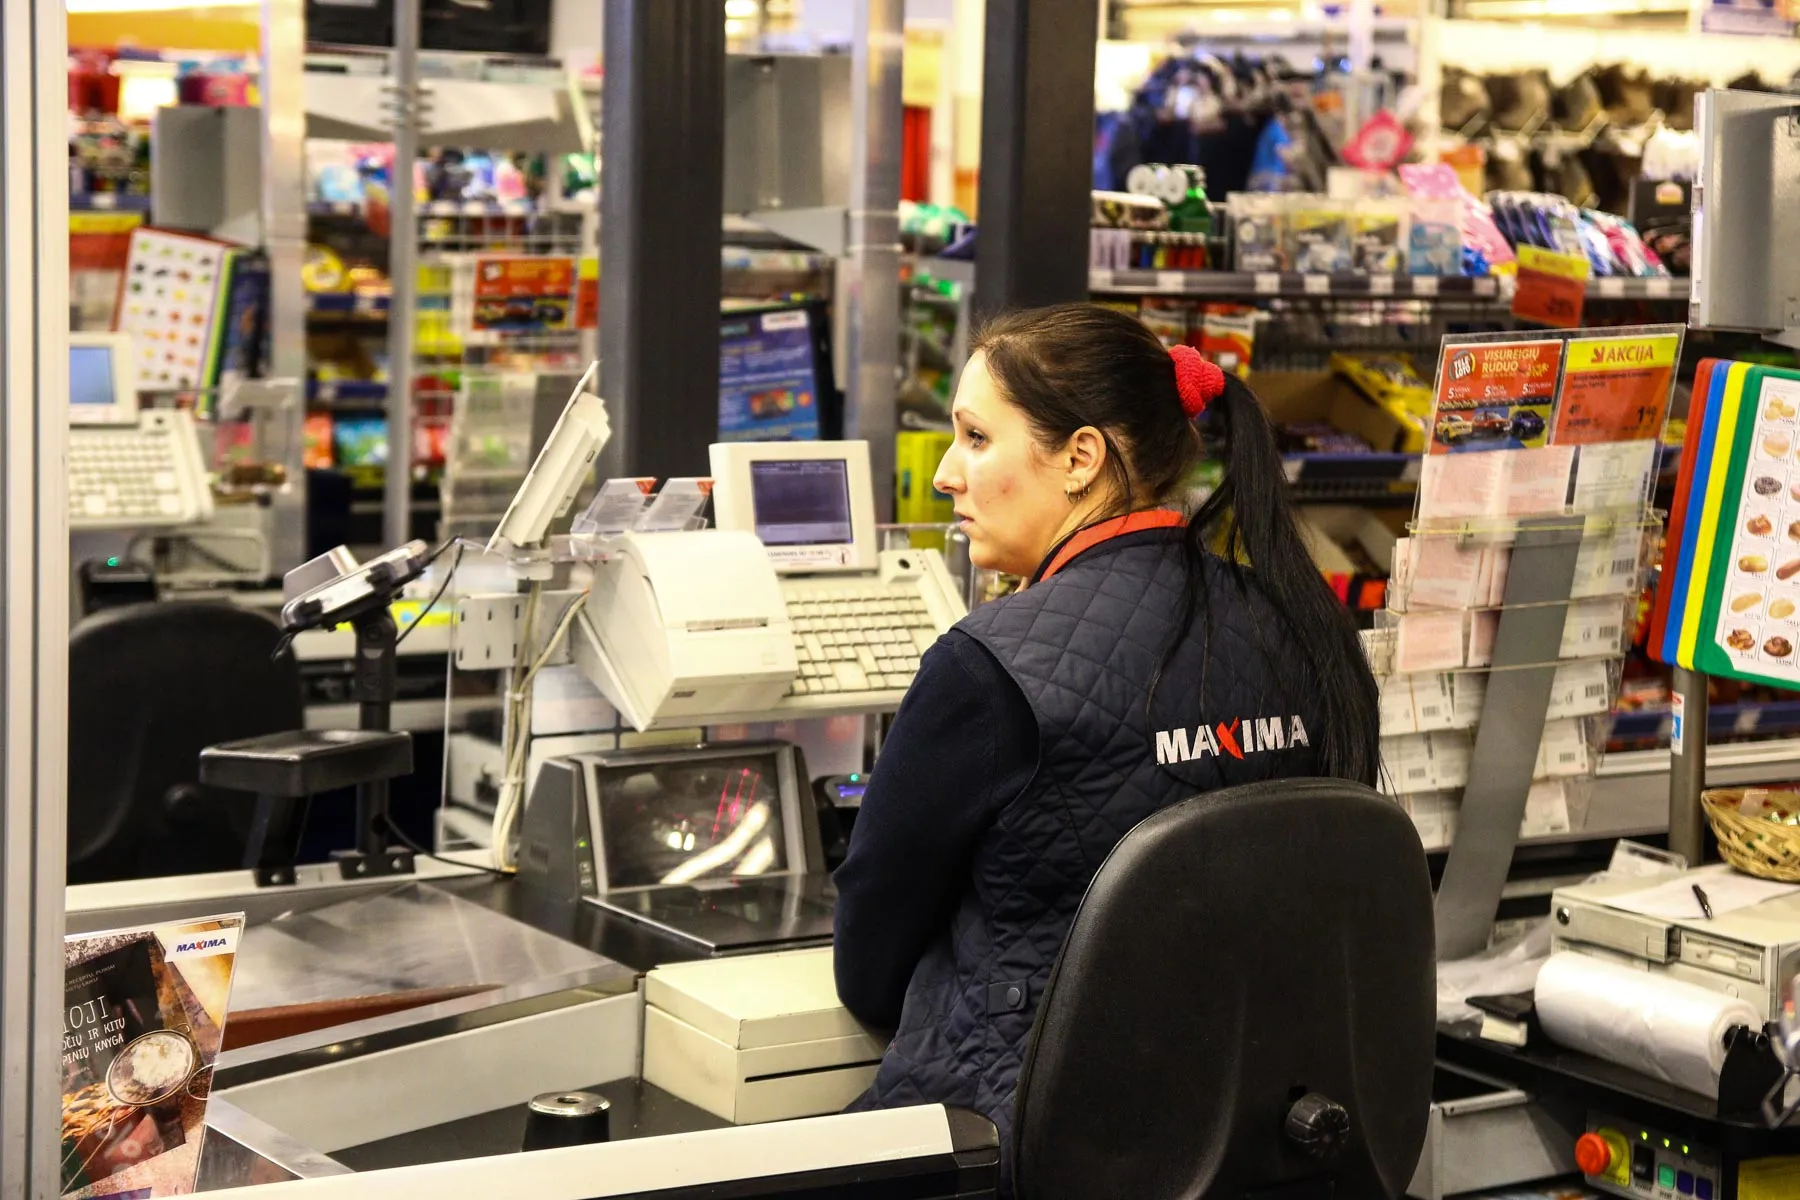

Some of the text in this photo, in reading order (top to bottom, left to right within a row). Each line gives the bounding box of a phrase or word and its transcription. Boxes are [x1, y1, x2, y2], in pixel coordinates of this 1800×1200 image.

[1606, 345, 1654, 363] AKCIJA
[1482, 361, 1518, 373] RUDUO
[1155, 714, 1310, 765] MAXIMA
[176, 938, 227, 952] MAXIMA
[88, 1028, 99, 1040] IR
[94, 1033, 124, 1053] KNYGA
